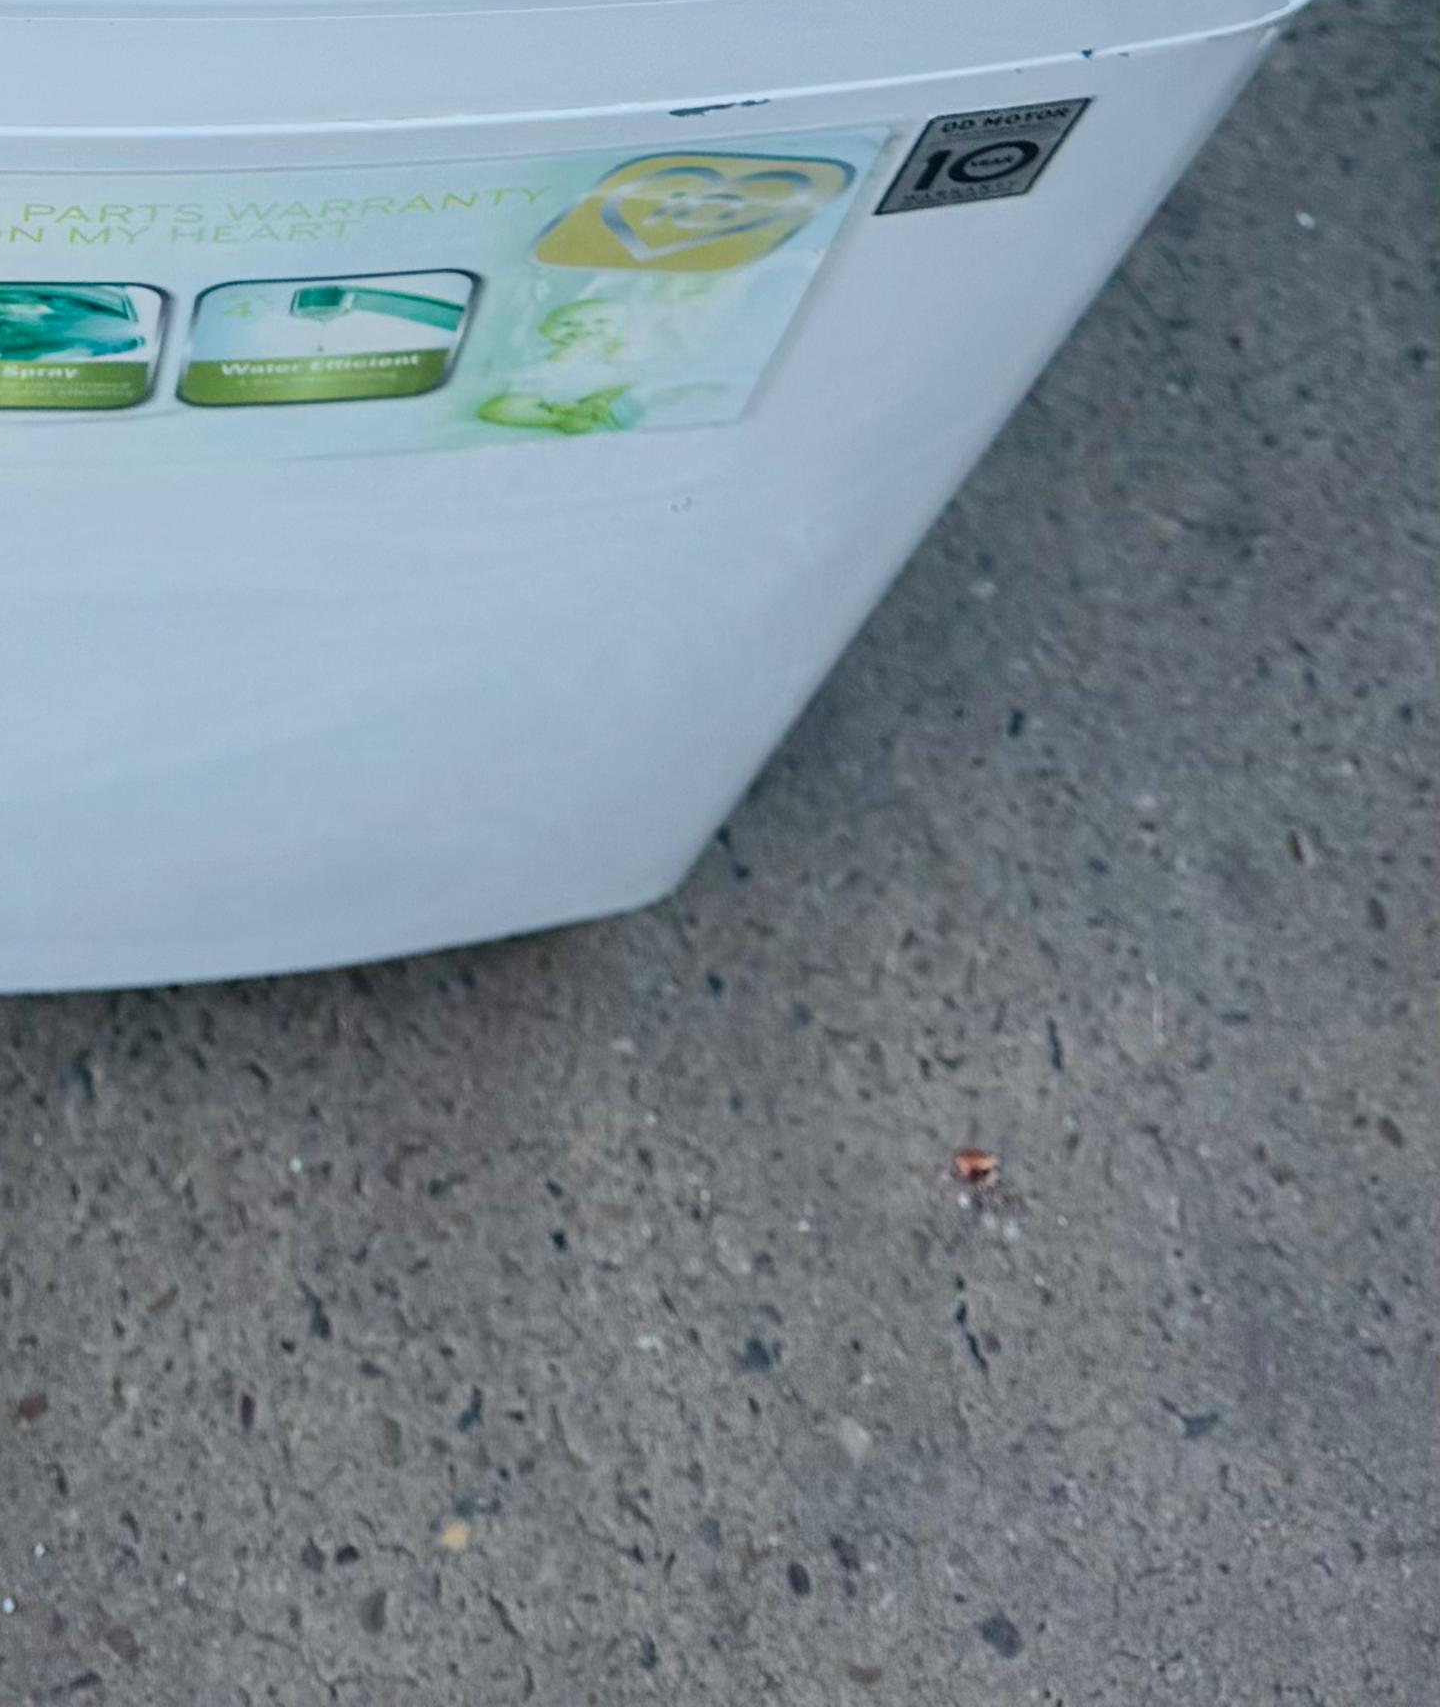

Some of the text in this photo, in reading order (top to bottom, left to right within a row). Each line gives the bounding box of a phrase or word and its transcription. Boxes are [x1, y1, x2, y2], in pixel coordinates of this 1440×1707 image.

[941, 119, 975, 133] DD
[983, 107, 1071, 127] MOTOR
[913, 140, 1039, 190] 10
[23, 203, 203, 224] PARTS
[227, 186, 552, 221] WARRANTY
[68, 226, 150, 244] MY
[170, 220, 358, 244] HEART
[1, 365, 79, 380] Spray
[221, 354, 420, 376] Water Efficient
